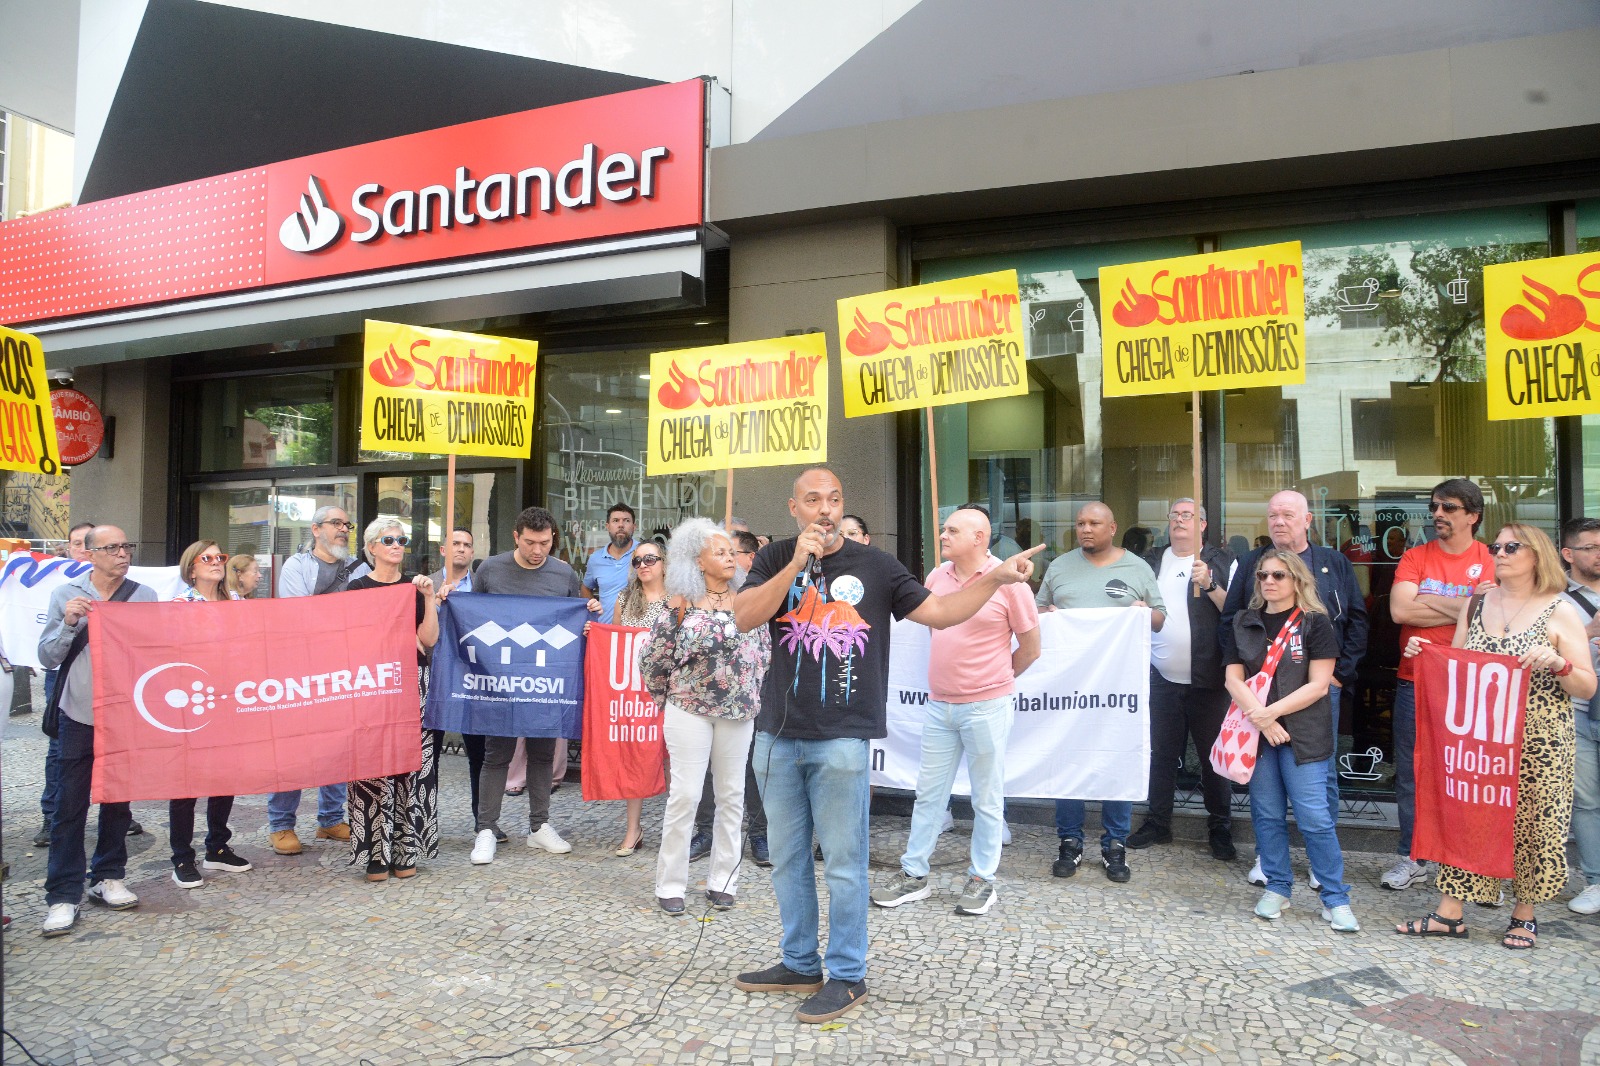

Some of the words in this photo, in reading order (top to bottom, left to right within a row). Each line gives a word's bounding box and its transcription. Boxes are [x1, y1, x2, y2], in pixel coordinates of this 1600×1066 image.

[350, 143, 669, 243] Santander
[885, 289, 1018, 350] Santander
[1152, 260, 1298, 325] Santander
[410, 339, 535, 398] Santander
[860, 355, 918, 405] CHEGA
[916, 364, 928, 380] de
[930, 339, 1020, 395] DEMISSÕES
[1116, 336, 1175, 383] CHEGA
[1174, 345, 1189, 362] de
[1192, 319, 1299, 377] DEMISSÕES
[1505, 342, 1591, 406] CHEGA
[698, 350, 822, 407] Santander
[56, 431, 92, 444] CHANGE
[374, 396, 425, 442] CHEGA
[430, 412, 442, 427] DE
[448, 400, 527, 447] DEMISSÕES
[660, 414, 713, 462] CHEGA
[729, 401, 821, 455] DEMISSÕES
[565, 520, 608, 532] ласкав
[1395, 512, 1433, 524] conve
[235, 663, 394, 704] CONTRAF
[236, 705, 276, 713] Confederação
[277, 700, 302, 710] Nacional
[314, 693, 353, 704] Trabalhadores
[463, 673, 564, 694] SITRAFOSVI
[1445, 659, 1522, 745] UNI
[609, 719, 658, 742] union
[1444, 740, 1514, 775] global
[1445, 775, 1511, 808] union
